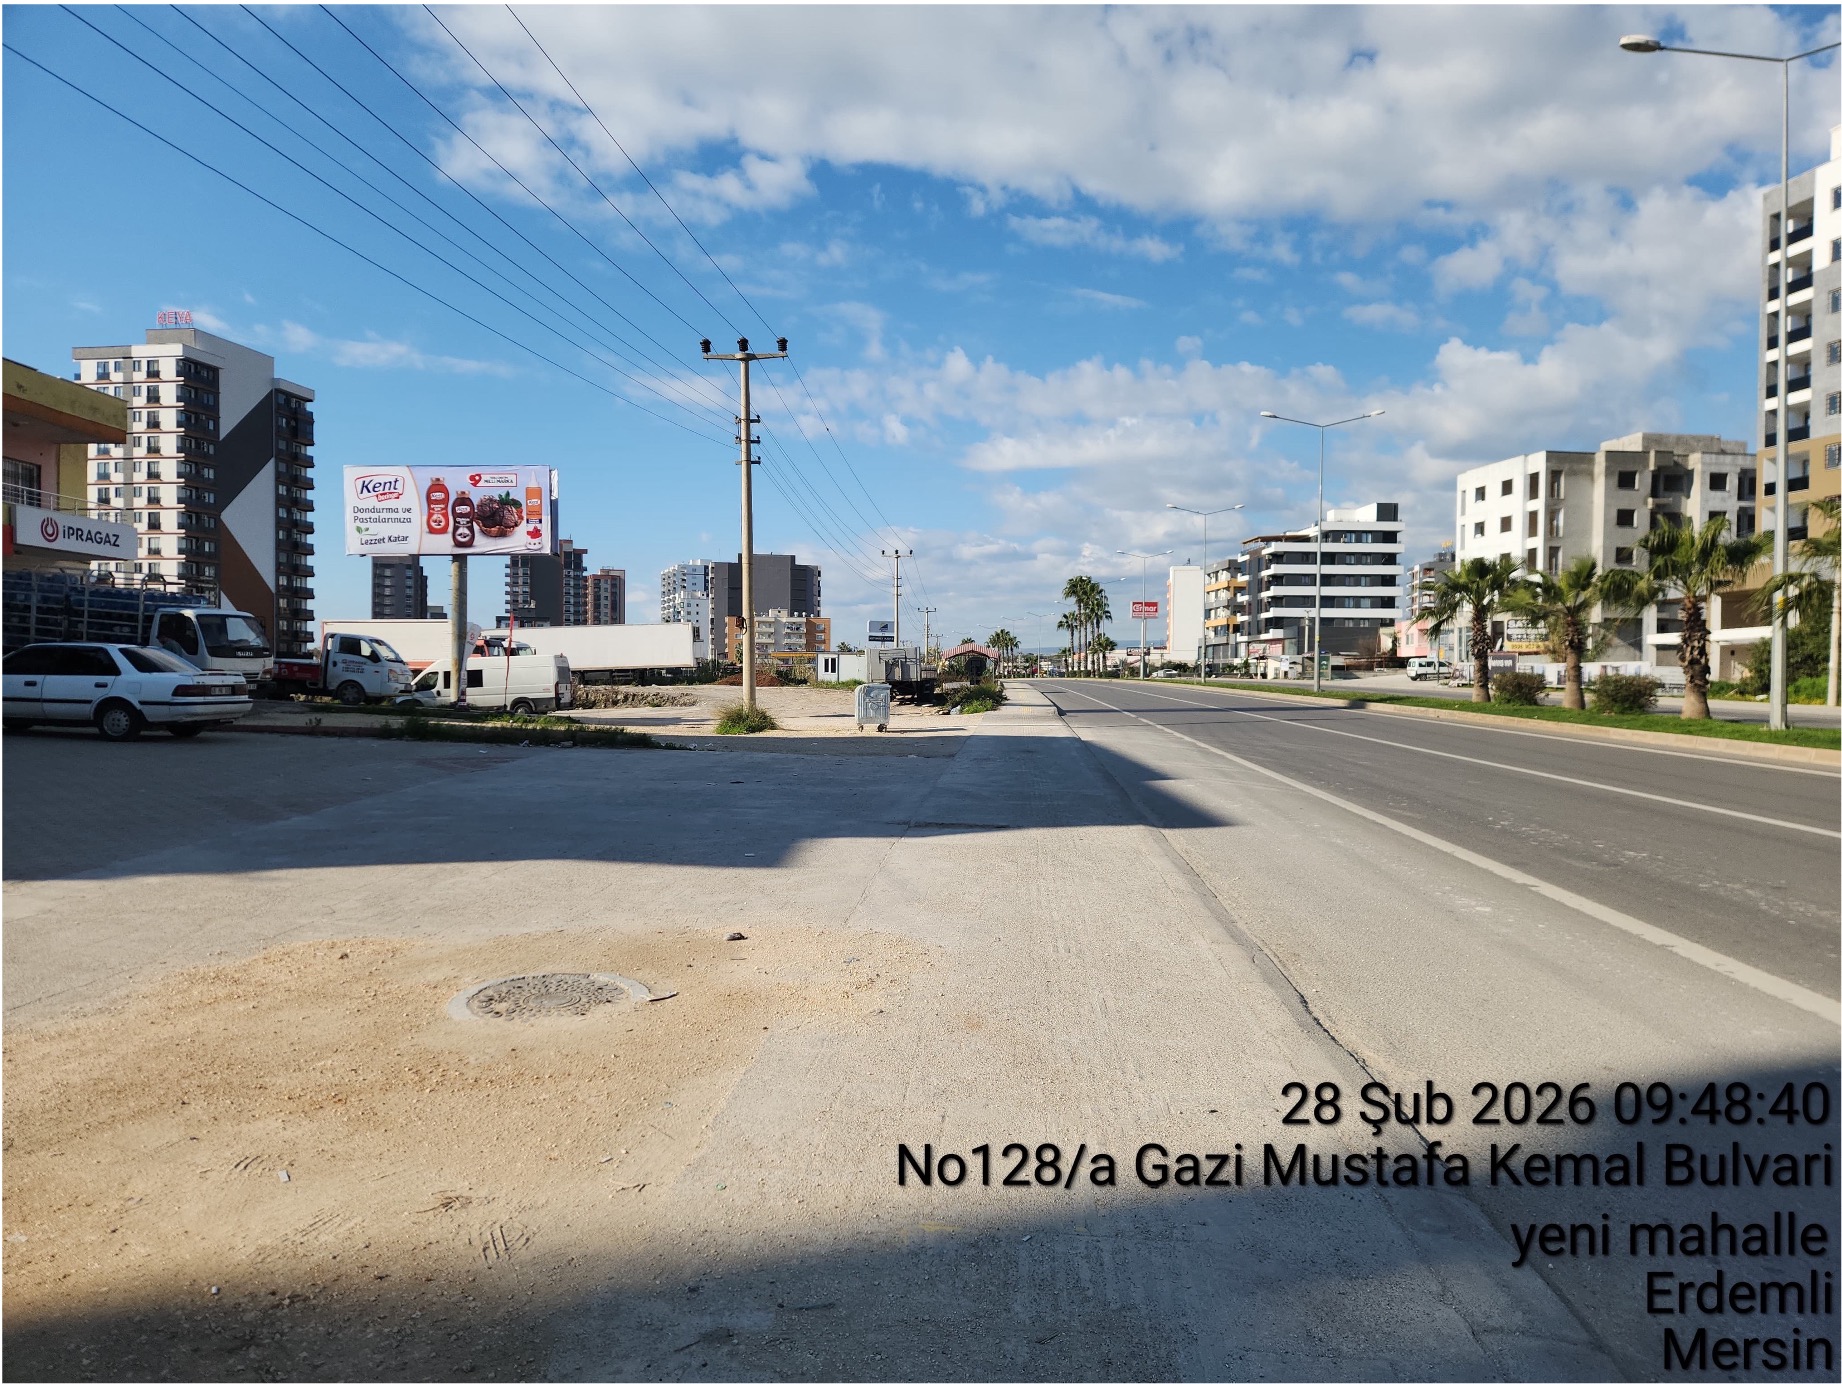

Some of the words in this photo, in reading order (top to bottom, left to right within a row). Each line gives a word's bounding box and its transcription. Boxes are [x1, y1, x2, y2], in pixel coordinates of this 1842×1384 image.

[157, 310, 193, 324] KEYA
[360, 478, 399, 495] Kent
[353, 506, 399, 514] Dondurma
[354, 515, 412, 524] Pastalarınıza
[360, 536, 386, 546] Lezzet
[388, 534, 410, 543] Katar
